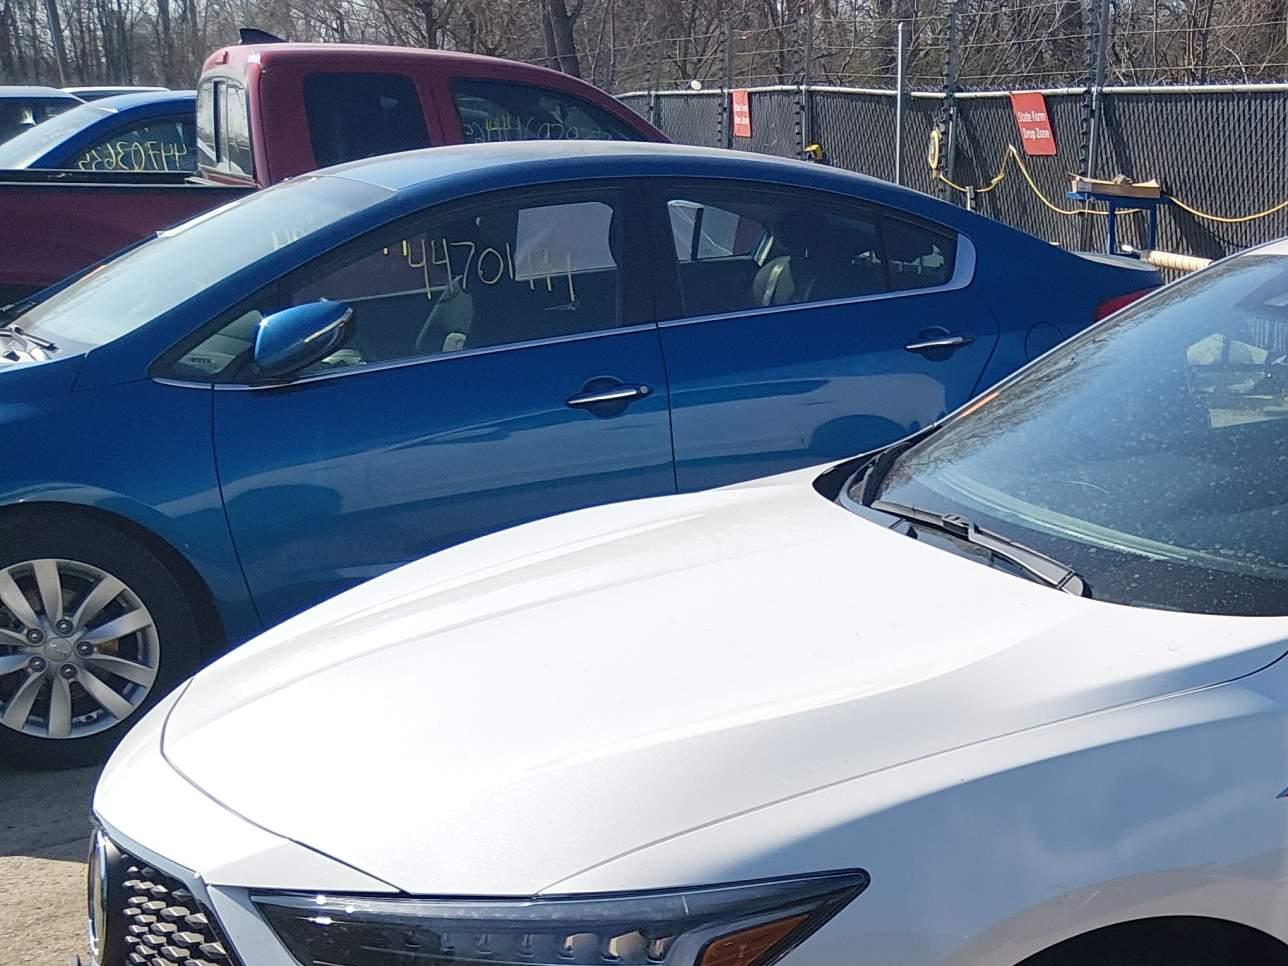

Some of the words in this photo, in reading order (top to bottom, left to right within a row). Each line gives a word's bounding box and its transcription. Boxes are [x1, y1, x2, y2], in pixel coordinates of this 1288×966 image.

[1017, 111, 1033, 122] State
[1032, 110, 1046, 122] Farm
[1022, 128, 1036, 141] Drop
